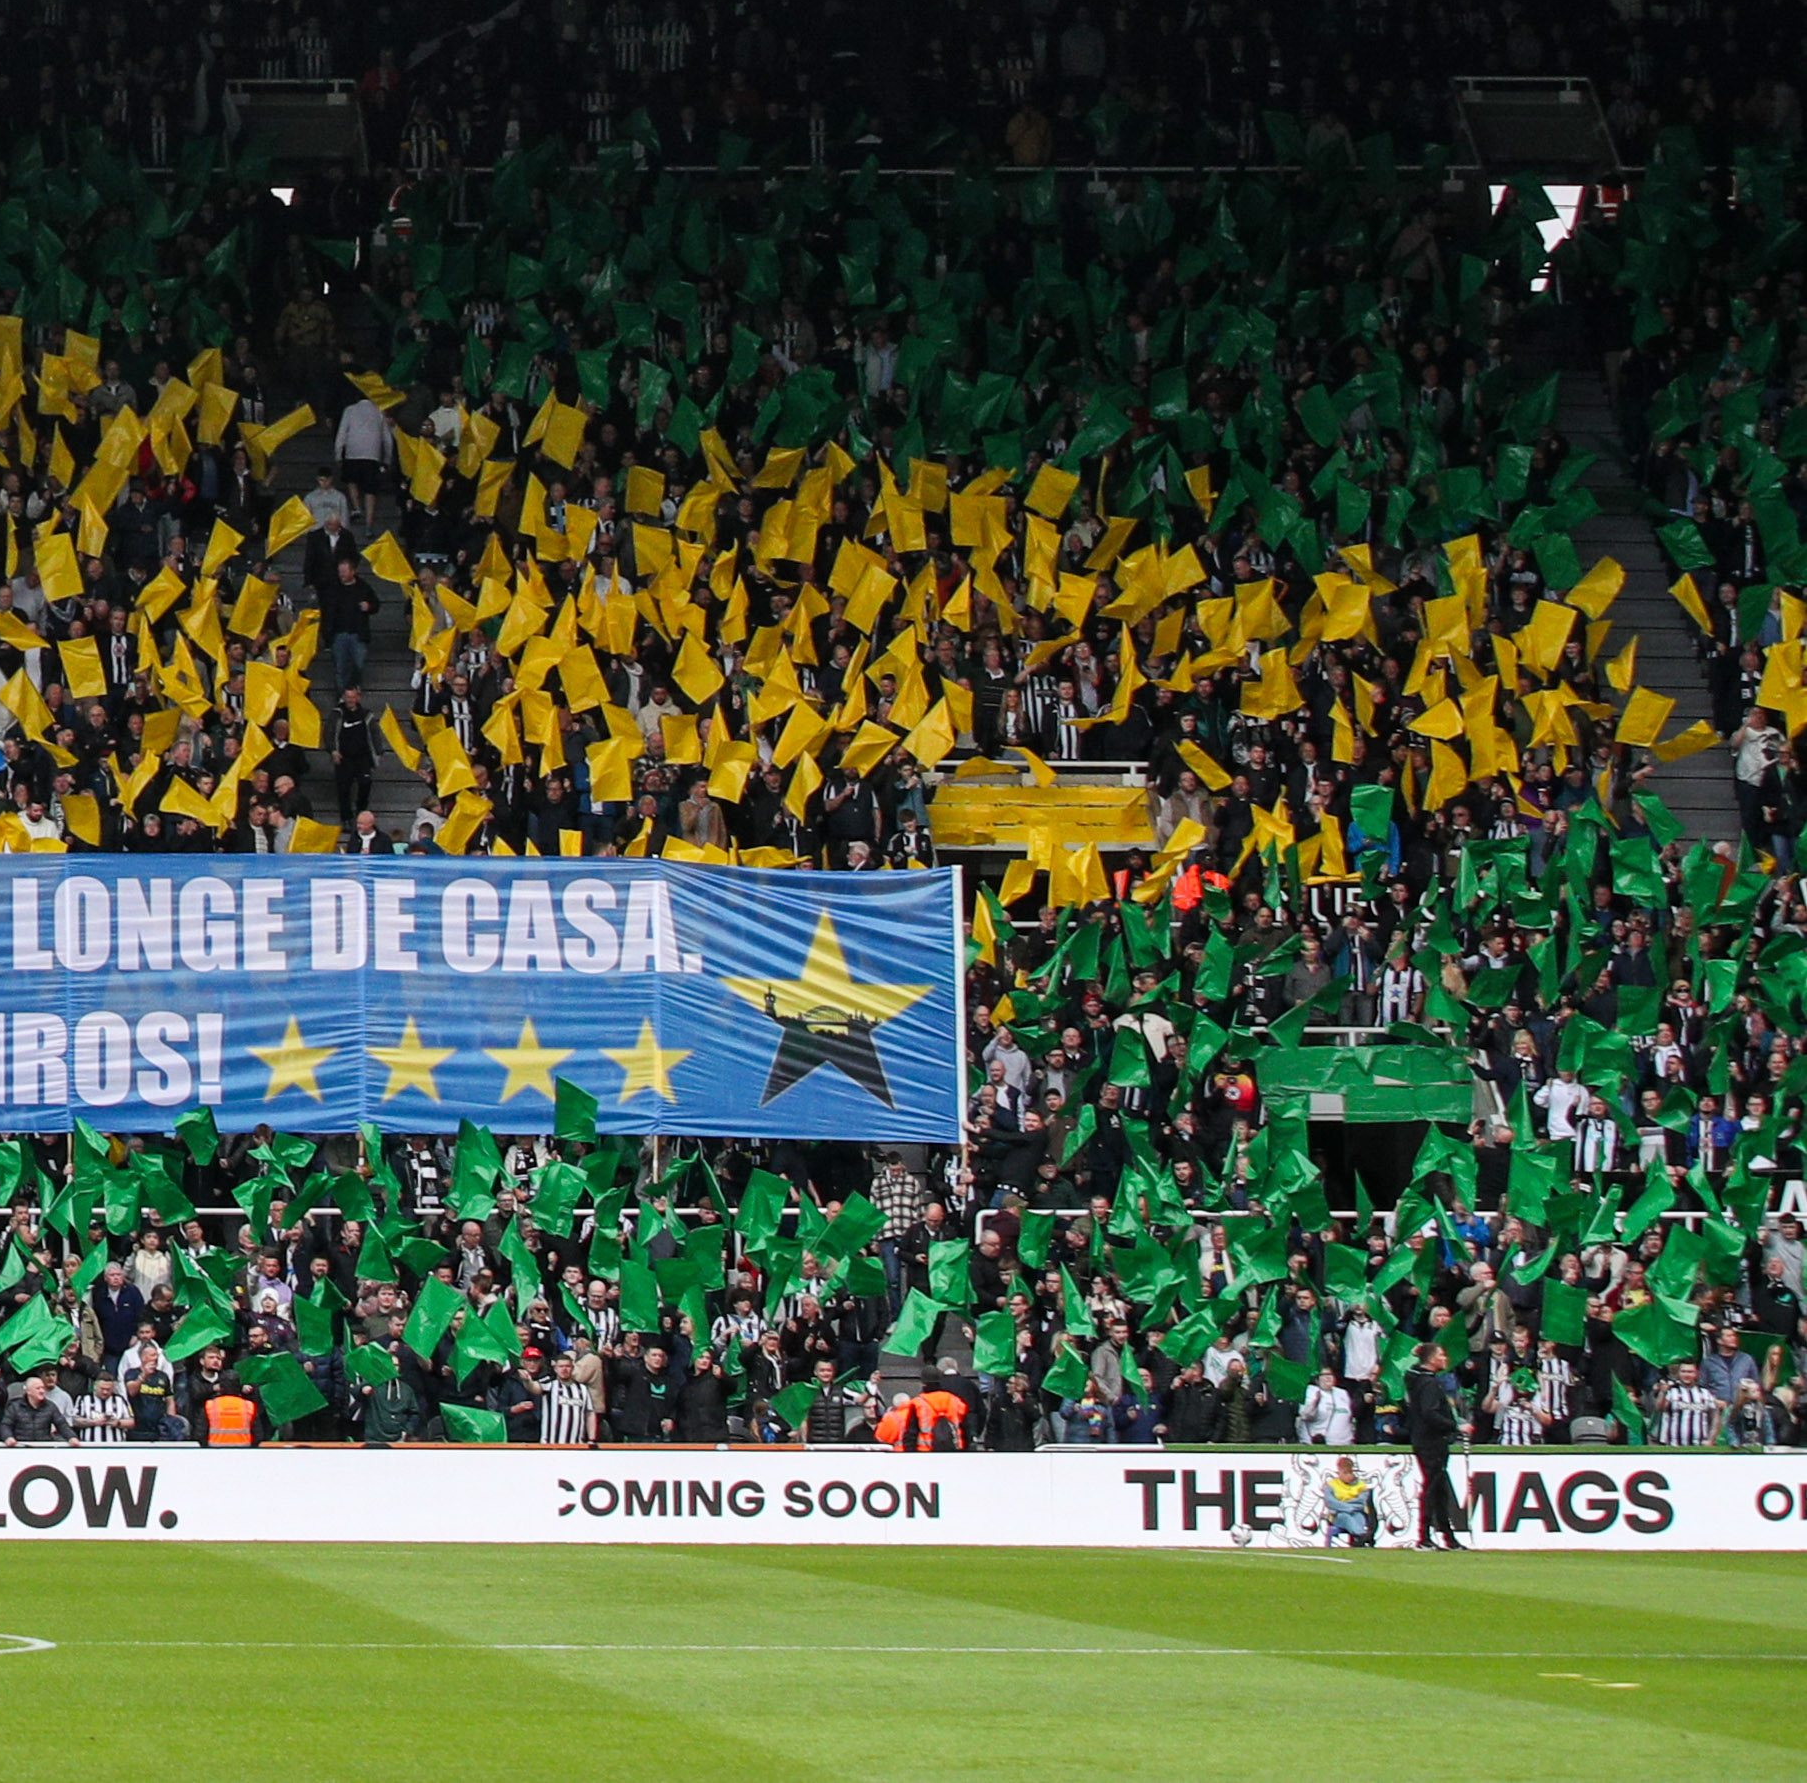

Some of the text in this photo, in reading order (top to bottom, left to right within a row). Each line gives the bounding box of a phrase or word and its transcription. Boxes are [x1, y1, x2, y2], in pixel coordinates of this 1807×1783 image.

[12, 877, 292, 974] LONGE
[311, 878, 421, 974] DE
[441, 878, 703, 975] CASA.
[785, 1481, 940, 1518] SOON
[1125, 1470, 1675, 1534] THE MAGS
[1755, 1483, 1807, 1521] O
